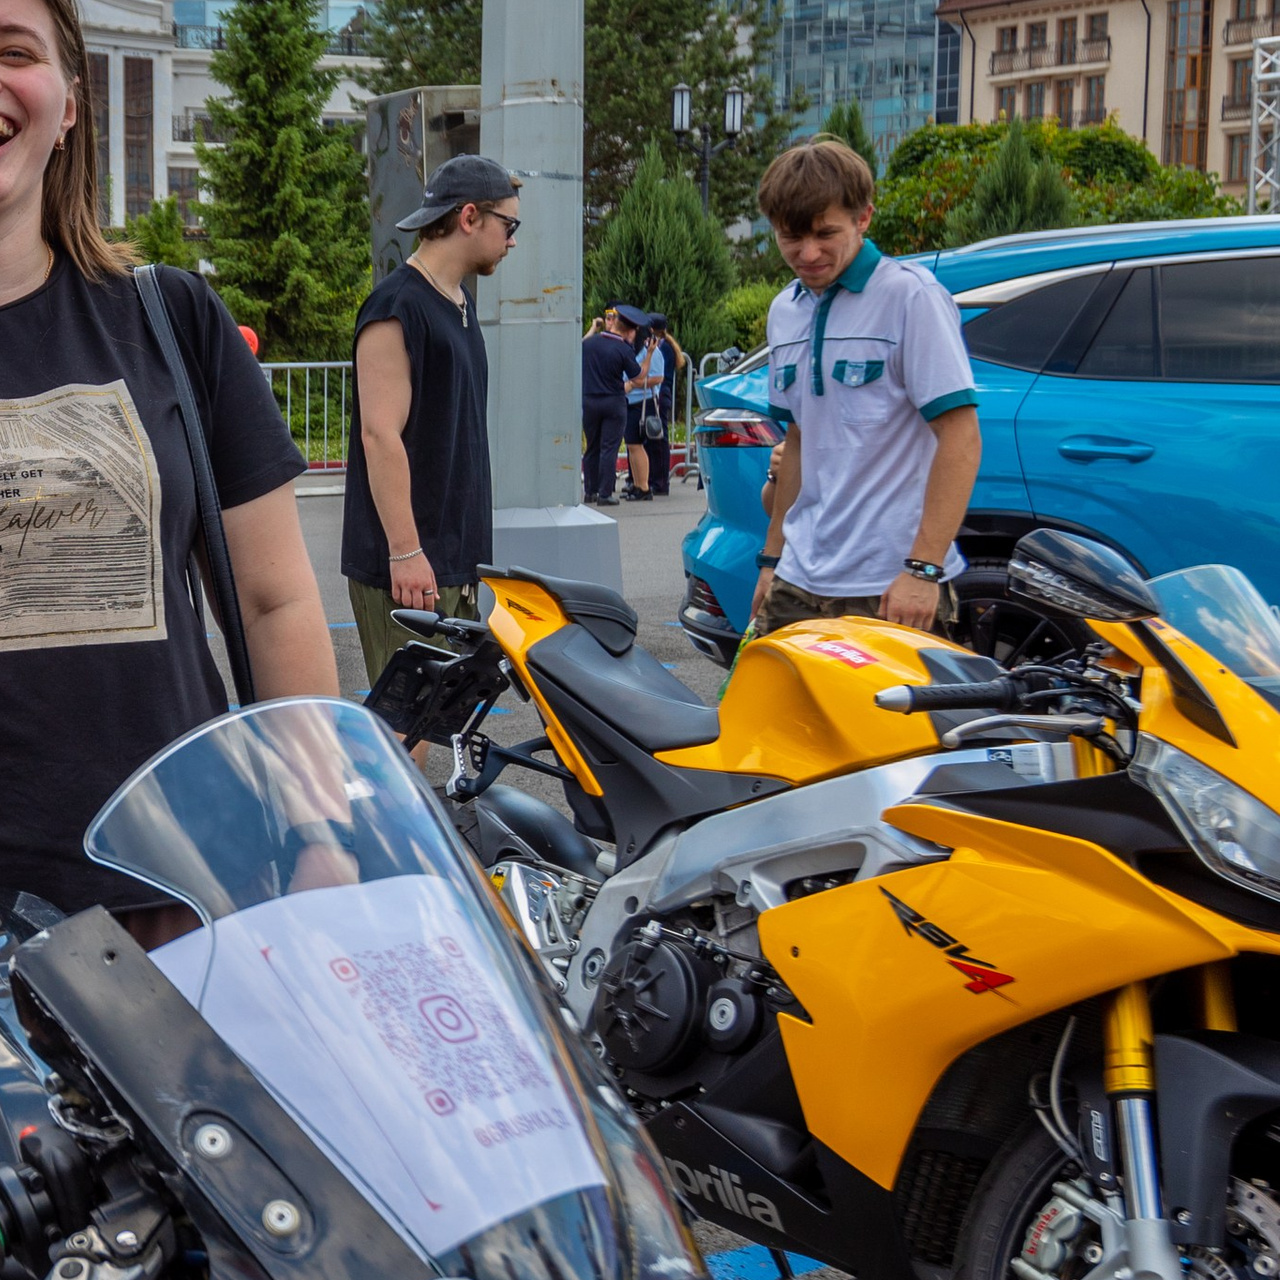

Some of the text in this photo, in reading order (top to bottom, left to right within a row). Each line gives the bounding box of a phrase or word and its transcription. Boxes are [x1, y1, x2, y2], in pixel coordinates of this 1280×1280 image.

[21, 469, 44, 479] GET
[665, 1156, 787, 1234] prilia
[1024, 1207, 1059, 1256] brembo
